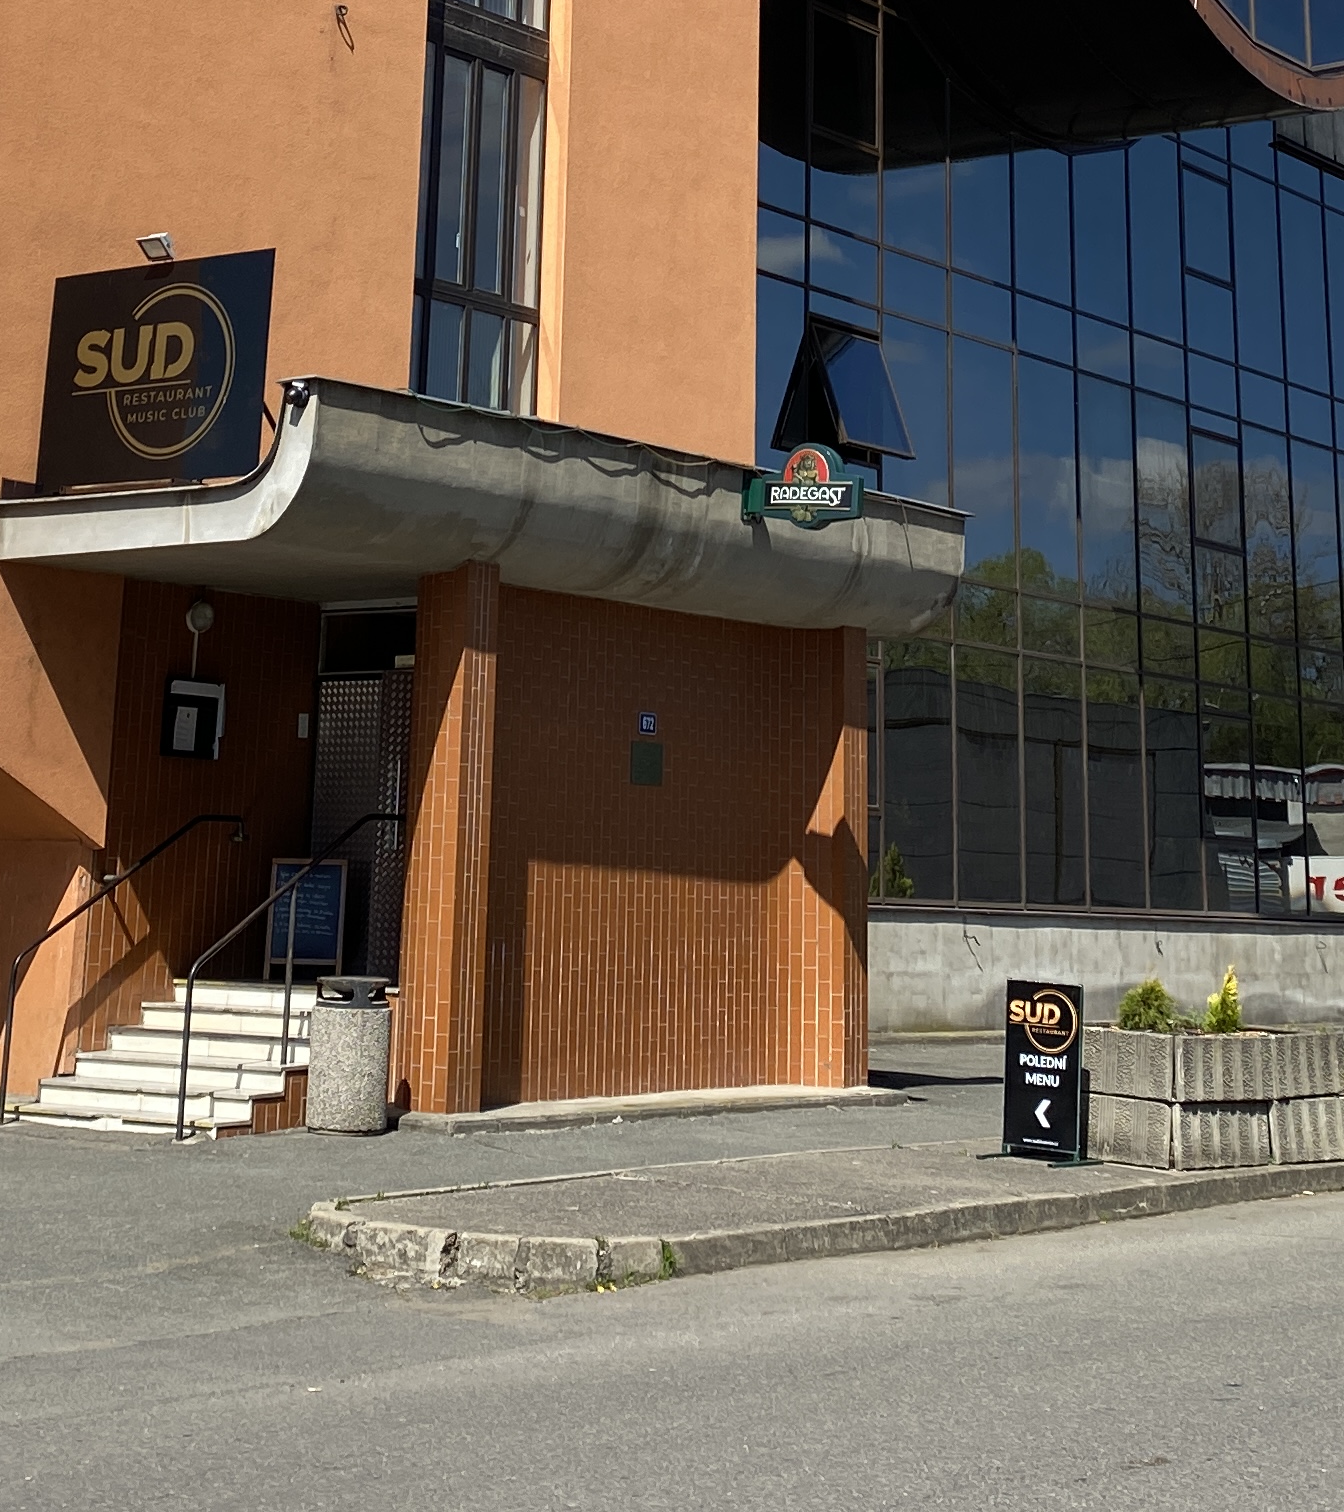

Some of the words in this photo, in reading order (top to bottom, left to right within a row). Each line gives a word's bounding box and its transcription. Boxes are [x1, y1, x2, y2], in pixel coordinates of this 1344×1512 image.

[72, 321, 195, 388] SUD
[123, 385, 213, 407] RESTAURANT
[126, 409, 167, 424] MUSIC
[171, 405, 206, 420] CLUB
[770, 486, 846, 506] RADEGAST
[643, 716, 654, 731] 672
[1009, 999, 1061, 1025] SUD
[1031, 1027, 1069, 1037] RESTAURANT
[1019, 1053, 1068, 1070] POLEDNÍ
[1025, 1072, 1060, 1088] MENU
